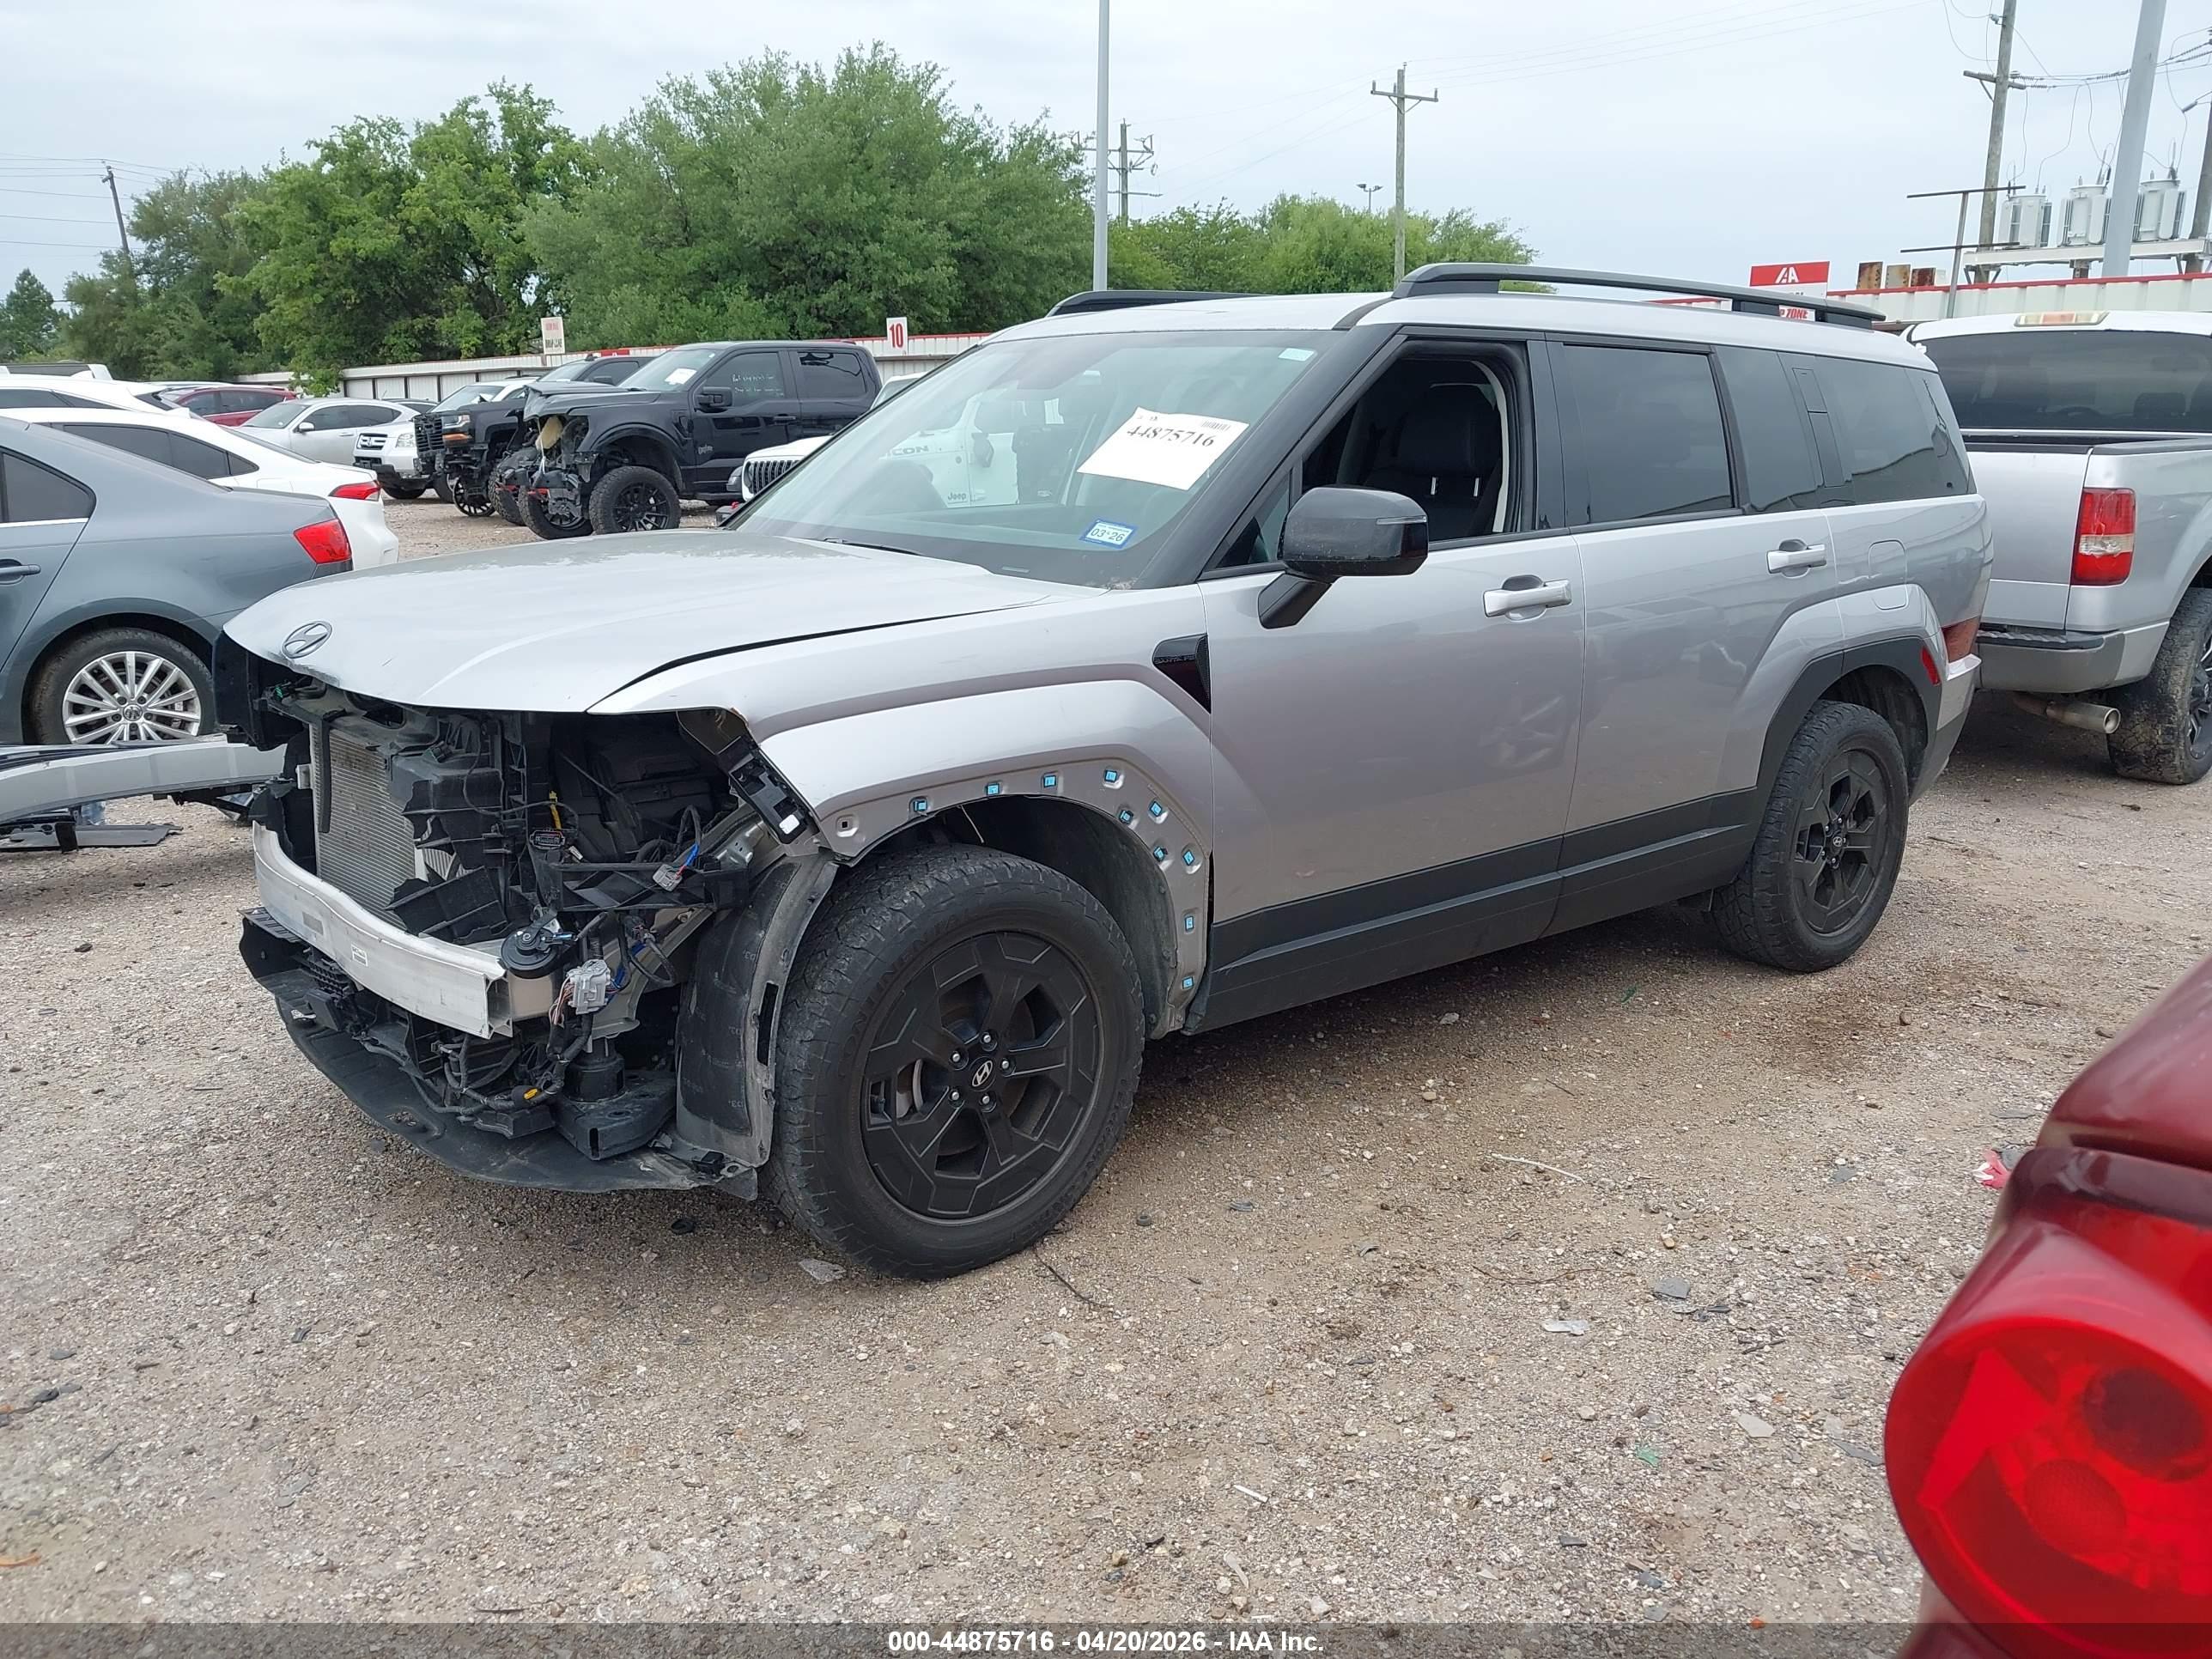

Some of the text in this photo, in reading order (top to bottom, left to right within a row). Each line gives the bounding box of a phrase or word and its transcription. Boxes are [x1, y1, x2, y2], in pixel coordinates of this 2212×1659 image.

[1786, 308, 1808, 319] ZONE
[890, 323, 903, 348] 10
[1127, 425, 1216, 447] 44875716
[947, 492, 967, 501] Jeep
[1091, 528, 1106, 538] 03
[1109, 532, 1126, 542] 26
